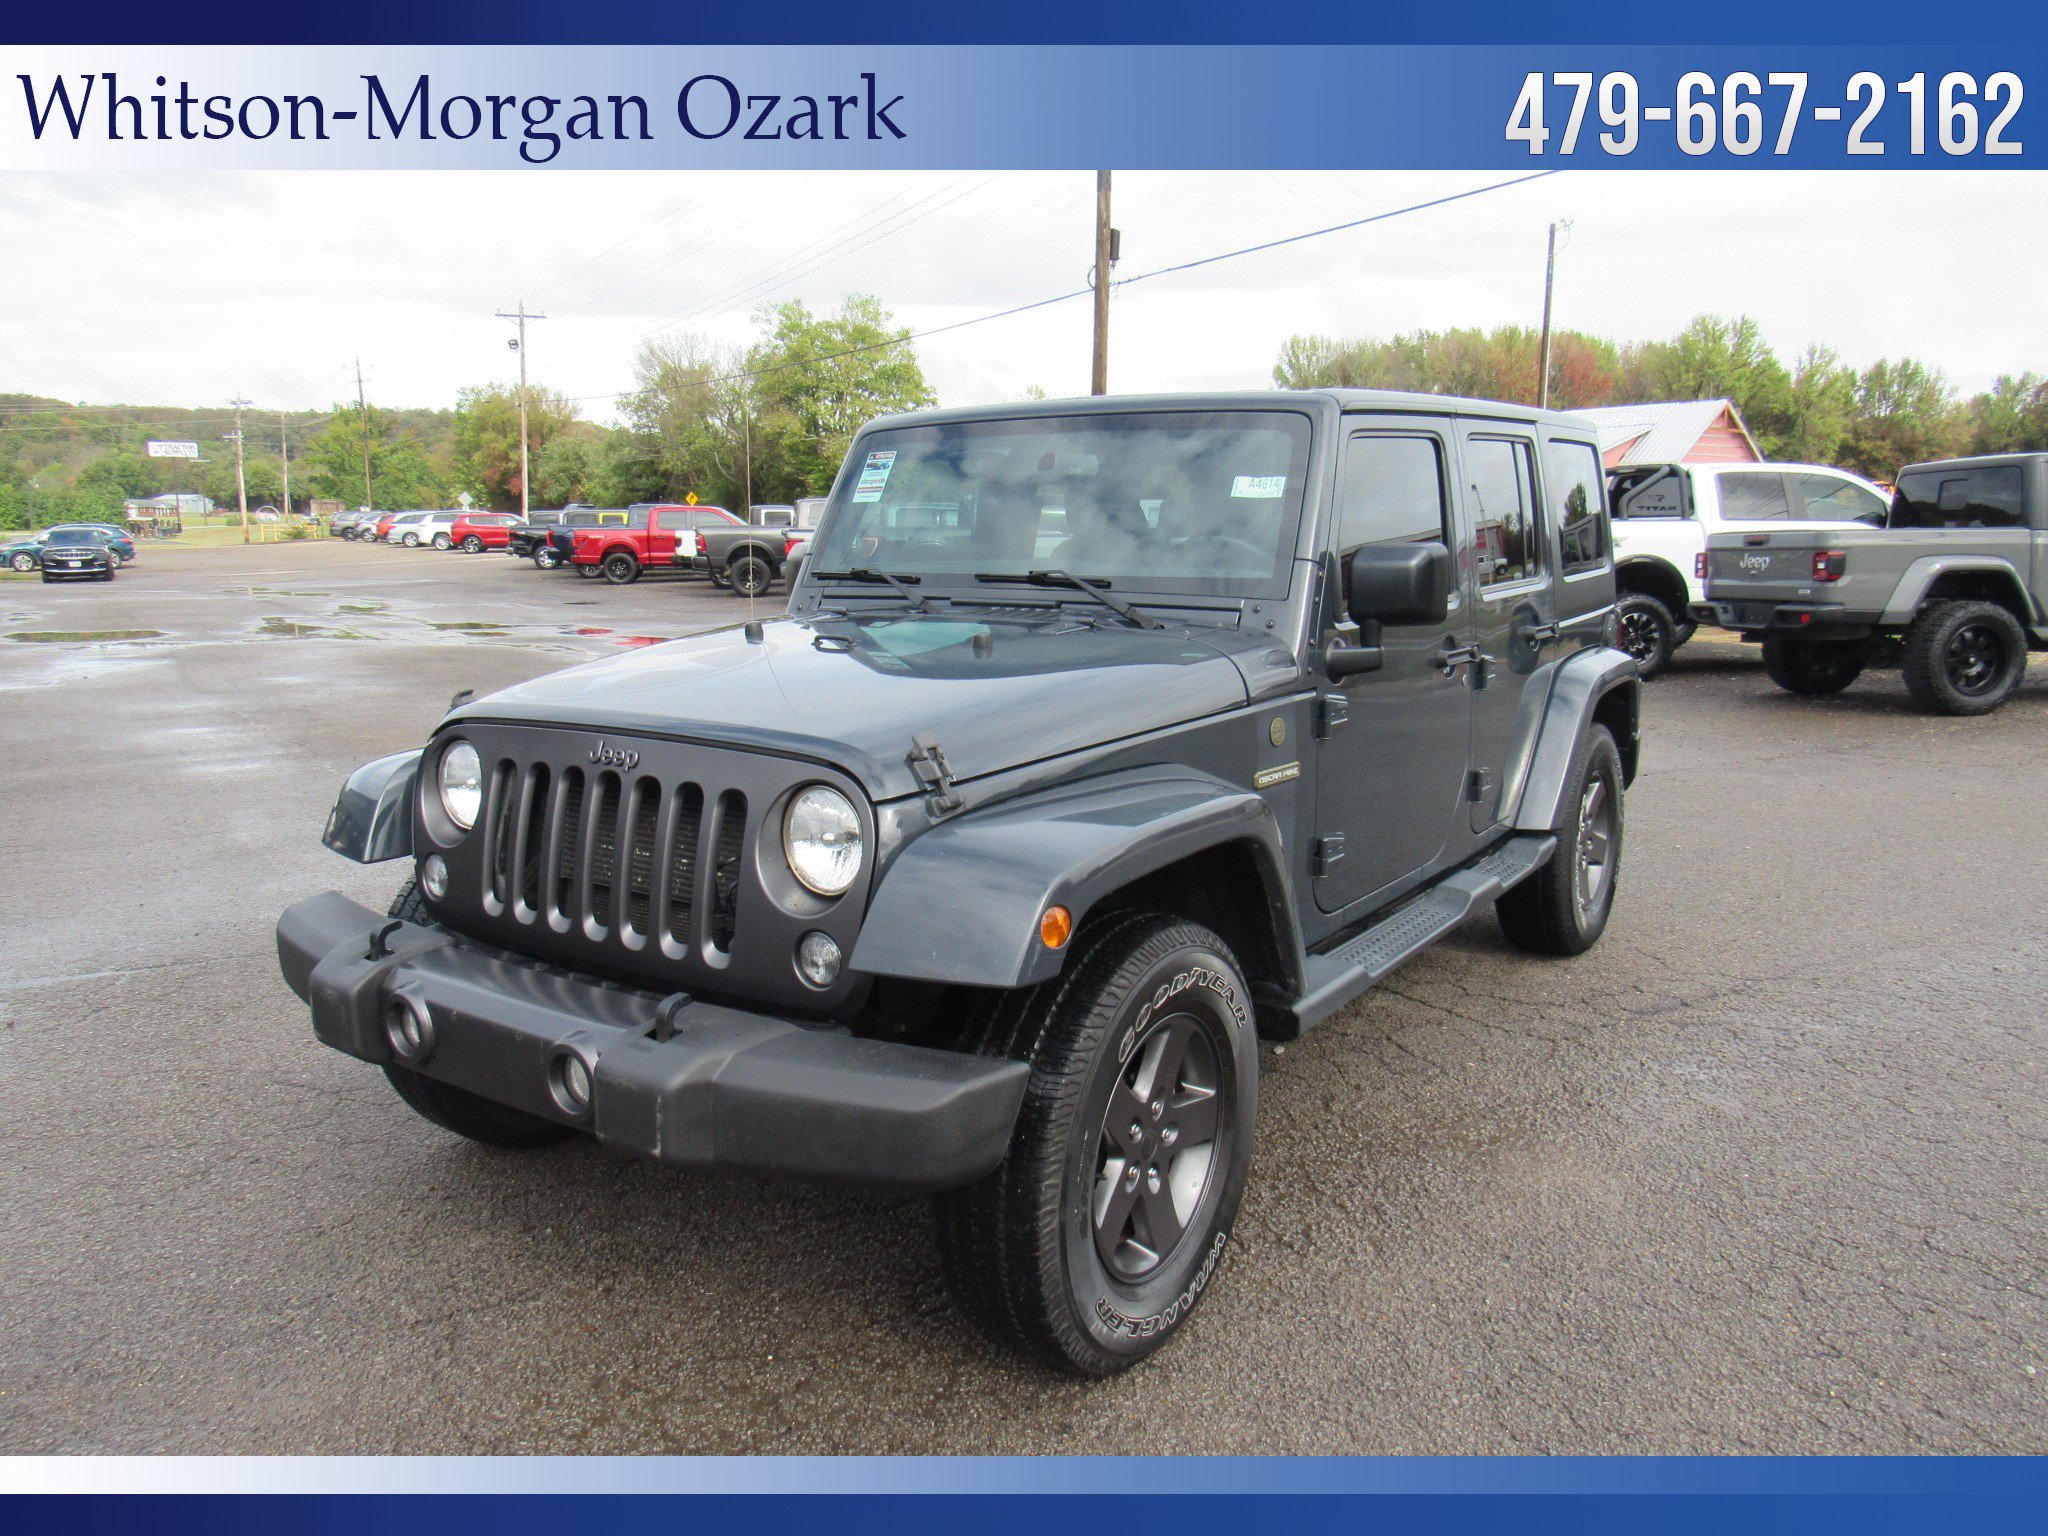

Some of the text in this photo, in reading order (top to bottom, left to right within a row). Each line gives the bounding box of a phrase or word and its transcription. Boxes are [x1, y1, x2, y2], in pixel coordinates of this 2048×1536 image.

[1740, 553, 1770, 571] Jeep
[587, 740, 641, 773] Jeep
[1118, 966, 1247, 1064] GOODYEAR
[1094, 1231, 1227, 1338] WRANGLER
